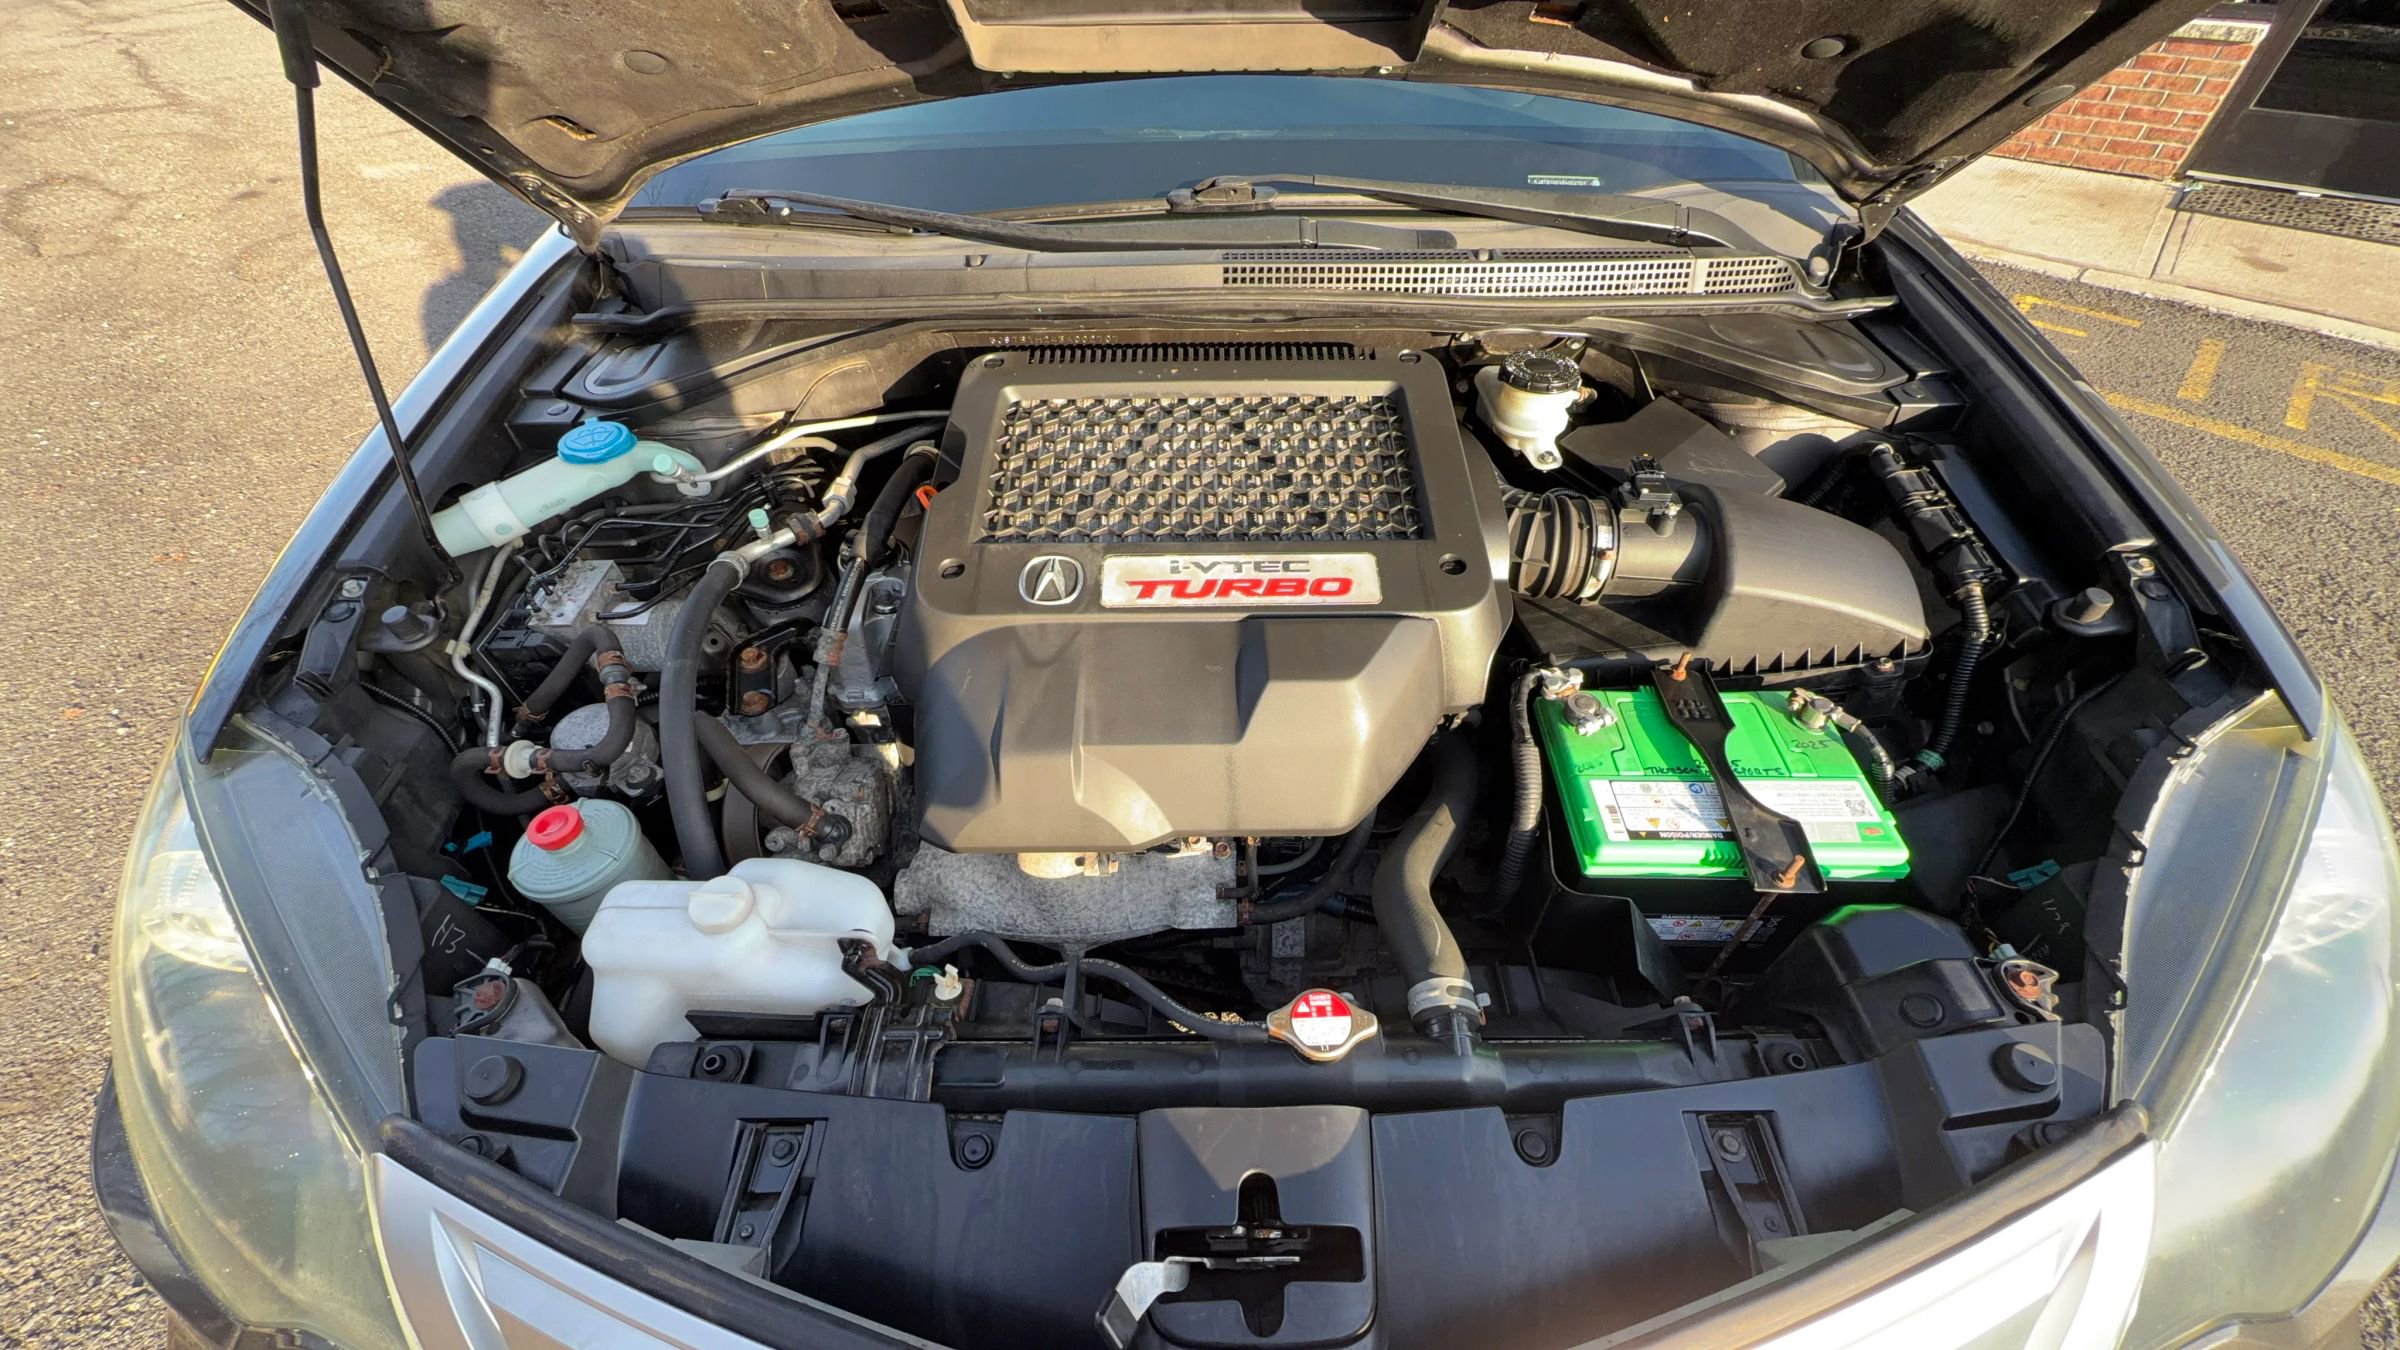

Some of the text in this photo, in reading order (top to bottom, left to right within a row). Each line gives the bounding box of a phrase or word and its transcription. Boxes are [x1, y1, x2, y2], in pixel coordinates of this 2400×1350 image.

[1126, 577, 1354, 599] TURBO
[1791, 739, 1832, 750] 2025
[1659, 831, 1724, 839] DANGER/POISON
